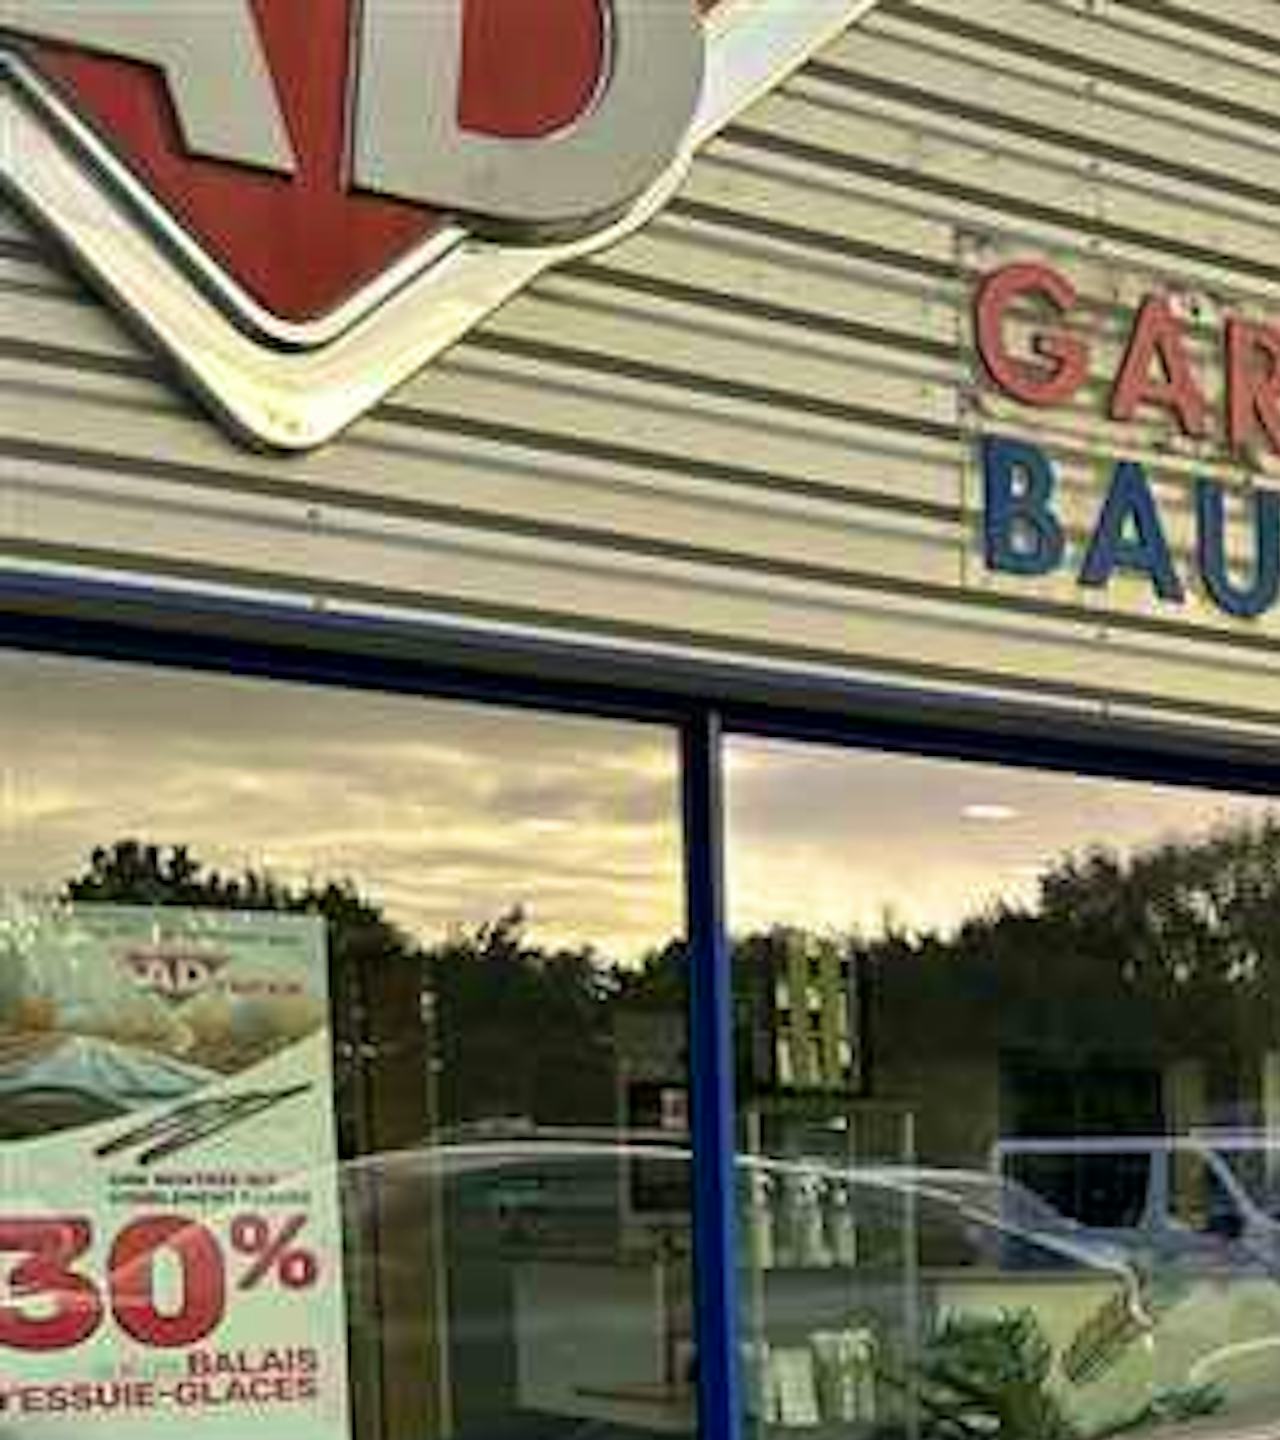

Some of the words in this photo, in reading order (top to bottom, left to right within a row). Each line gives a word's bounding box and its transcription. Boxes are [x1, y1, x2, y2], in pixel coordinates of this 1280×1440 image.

[0, 1213, 318, 1352] 30%
[188, 1350, 317, 1375] BALAIS
[0, 1378, 317, 1412] 'ESSUIE-GLACES
